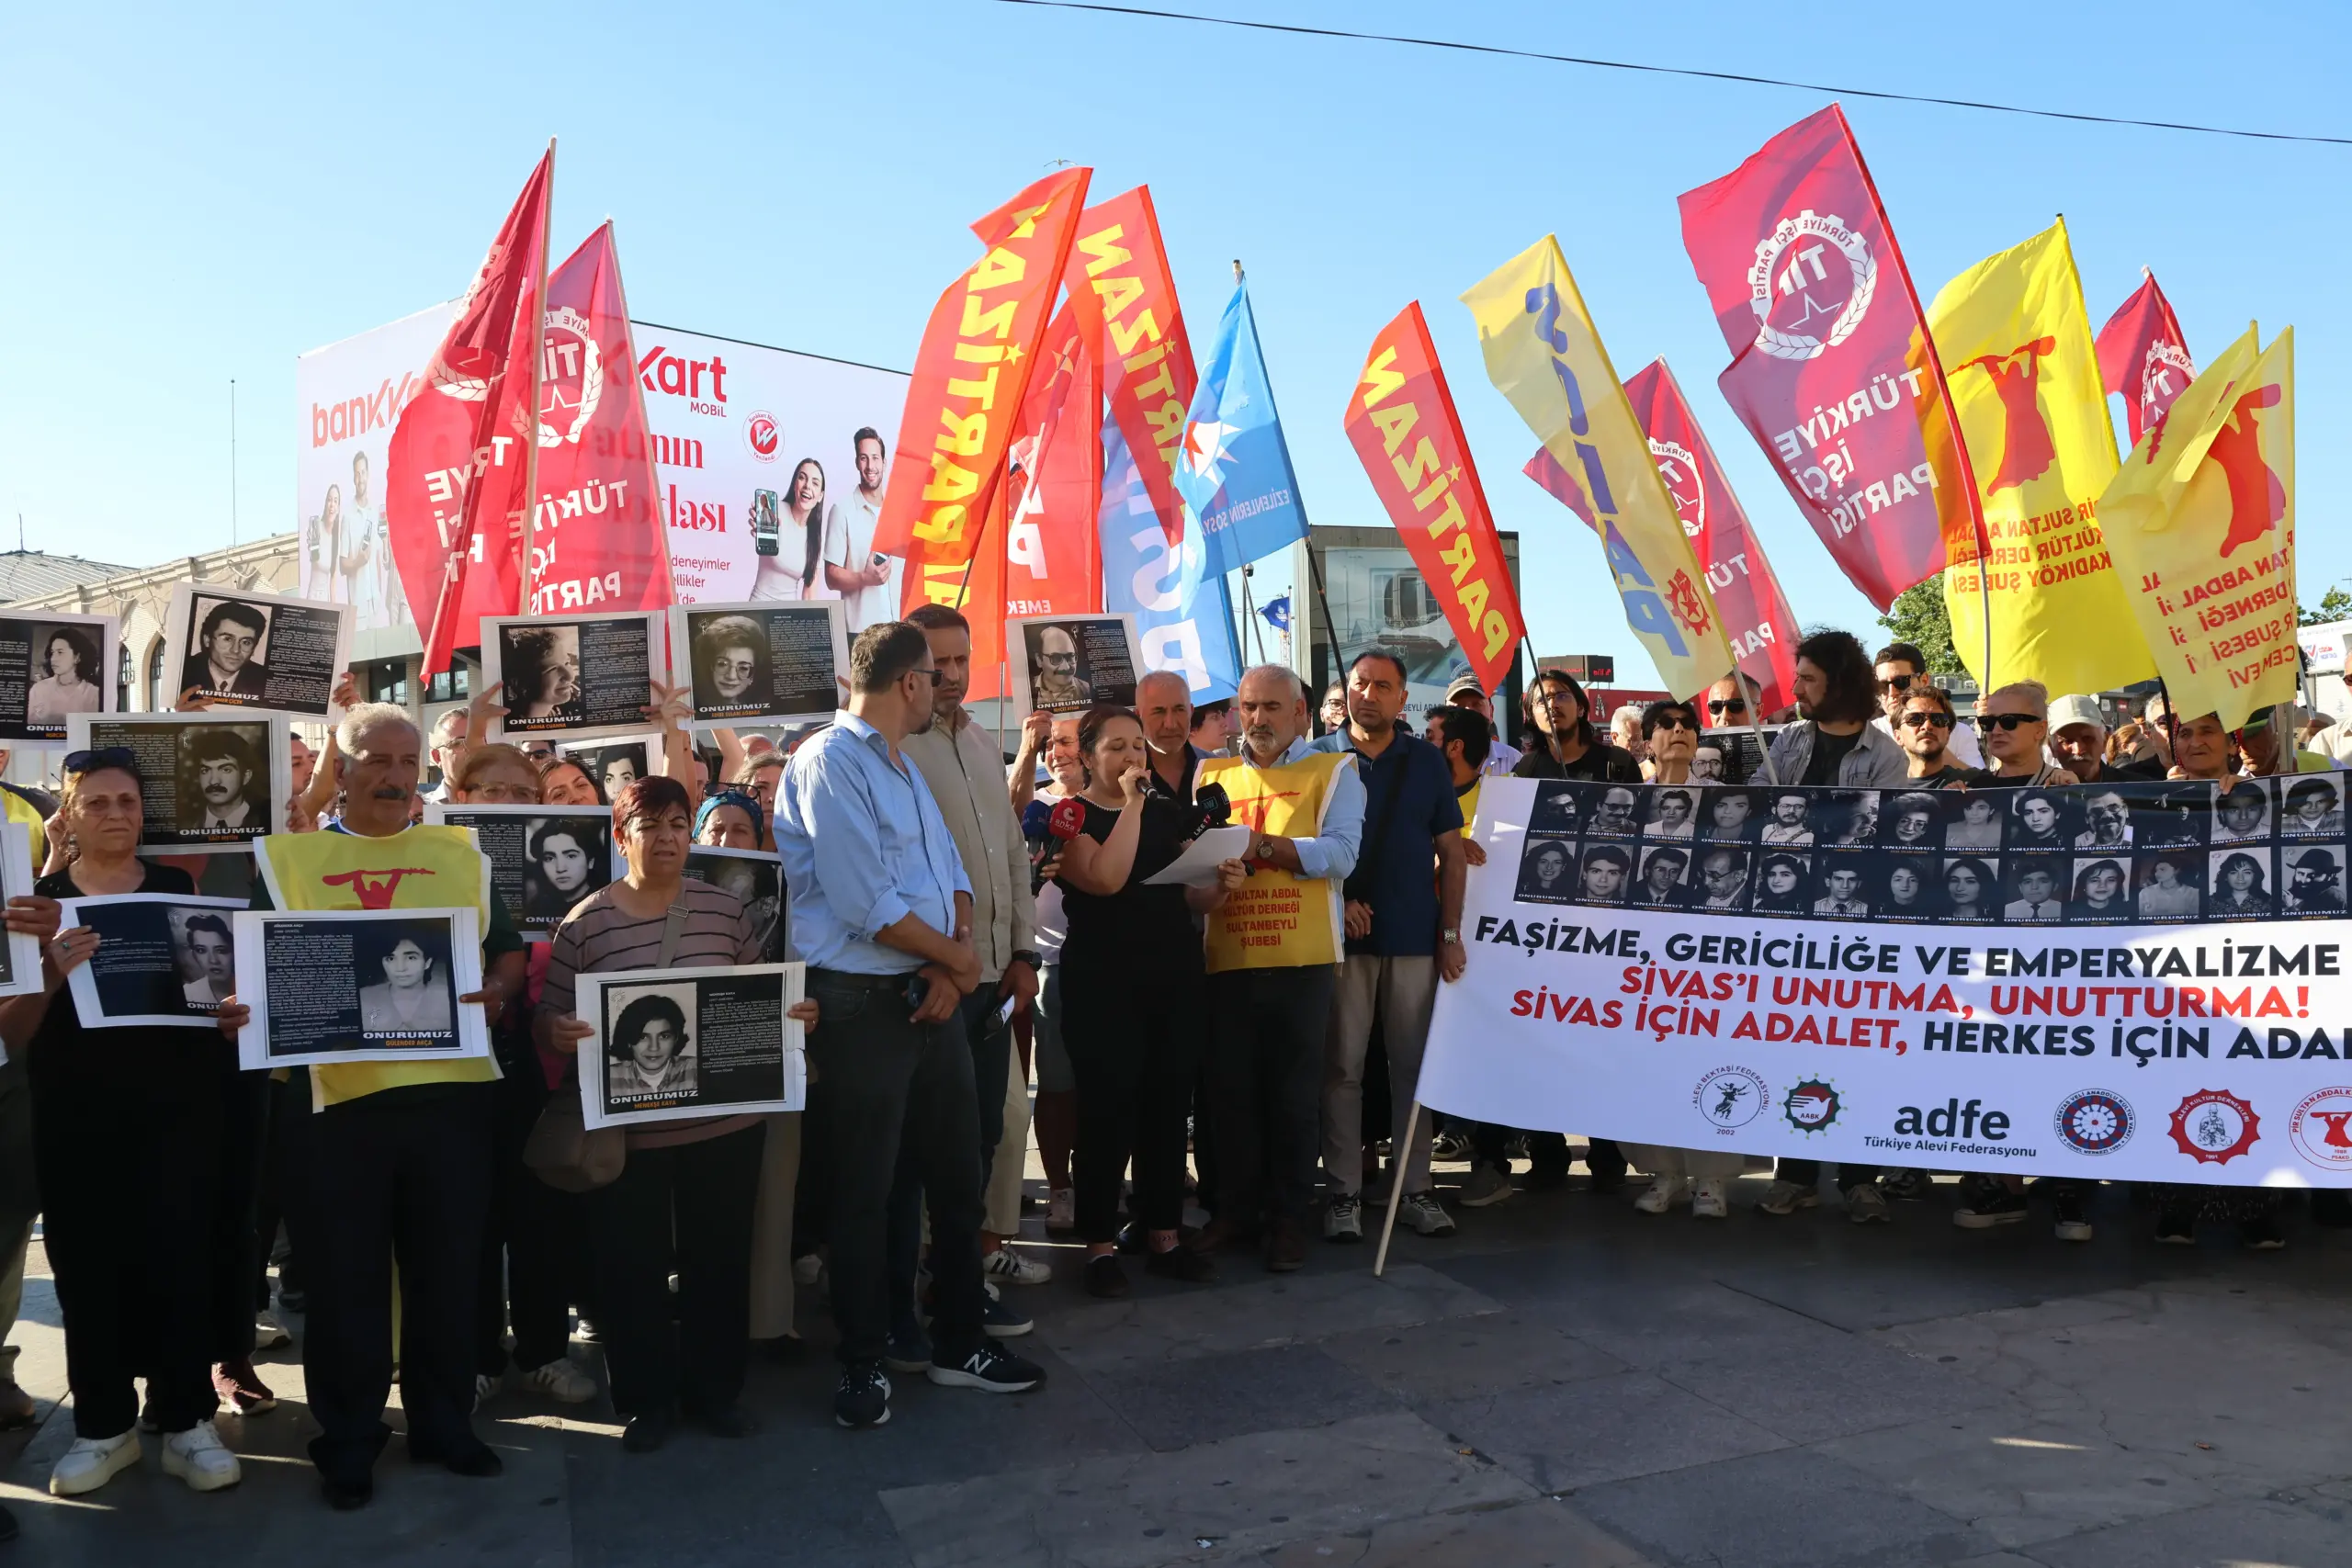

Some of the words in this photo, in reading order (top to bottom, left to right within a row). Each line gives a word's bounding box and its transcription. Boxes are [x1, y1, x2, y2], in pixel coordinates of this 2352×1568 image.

[195, 689, 259, 701] NURUMUZ
[699, 703, 771, 712] ONURUMUZ
[1036, 698, 1092, 709] ONURUMUZ
[509, 716, 582, 725] ONURUMUZ
[179, 827, 266, 836] ONURUMUZ
[2210, 834, 2271, 845] ONURUMUZ
[1234, 890, 1268, 903] SULTAN
[1272, 887, 1302, 899] ABDAL
[1258, 901, 1300, 915] DERNEĞİ
[1226, 917, 1297, 933] SULTANBEYLİ
[1240, 933, 1281, 950] ŞUBESİ
[1476, 916, 1650, 965] FAŞİZME,
[1665, 930, 1899, 973] GERİCİLİĞE
[1915, 945, 1971, 976] VE
[1984, 938, 2340, 978] EMPERYALİZME
[1772, 976, 1973, 1020] UNUTMA,
[1990, 985, 2311, 1019] UNUTTURMA!
[1510, 985, 1623, 1029] SİVAS
[1634, 996, 1721, 1043] İÇİN
[1731, 1012, 1908, 1055] ADALET,
[1924, 1021, 2095, 1056] HERKES
[2111, 1018, 2209, 1067] İÇİN
[363, 1031, 453, 1040] ONURUMUZ
[1701, 1064, 1735, 1084] BEKTAŞİ
[1736, 1066, 1770, 1111] FEDERASYONU
[2316, 1089, 2344, 1100] ABDAL
[610, 1090, 699, 1105] ONURUMUZ
[2086, 1090, 2119, 1100] ANADOLU
[2294, 1096, 2316, 1121] SULTAN
[1894, 1098, 2010, 1141] adfe
[1716, 1128, 1736, 1136] 2002
[2290, 1122, 2300, 1133] PİR
[1864, 1136, 1912, 1151] Türkiye
[1915, 1140, 1948, 1152] Alevi
[1951, 1143, 2037, 1157] Federasyonu
[964, 1353, 992, 1375] N
